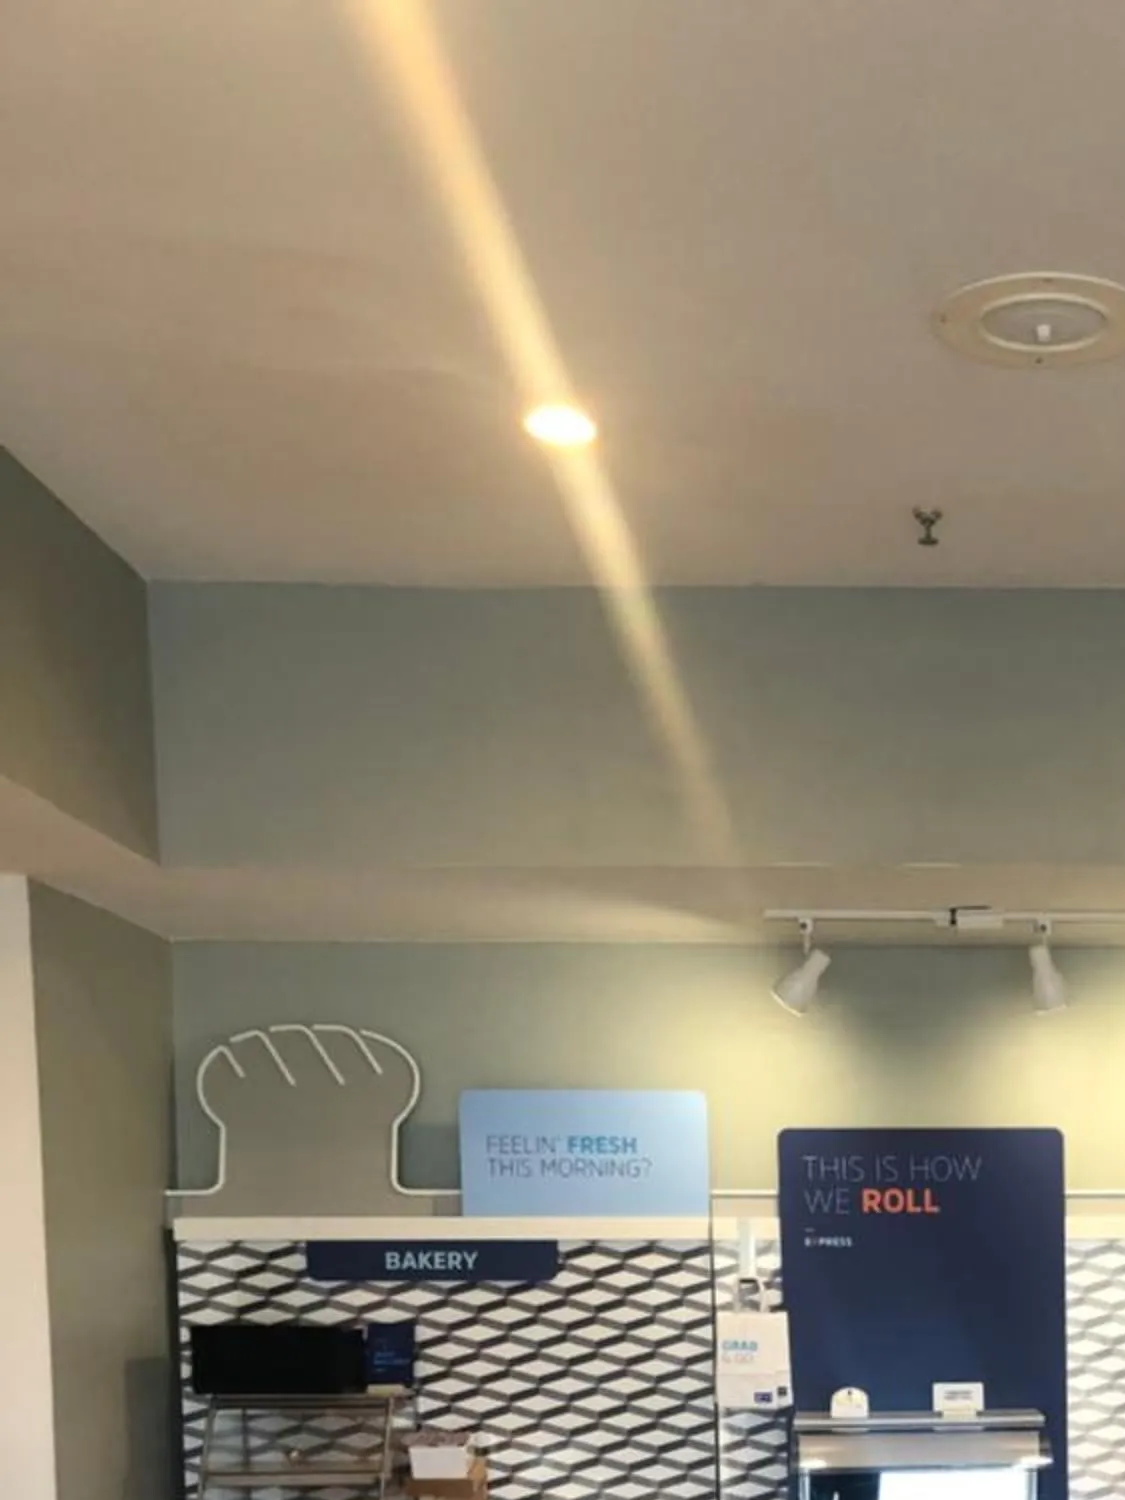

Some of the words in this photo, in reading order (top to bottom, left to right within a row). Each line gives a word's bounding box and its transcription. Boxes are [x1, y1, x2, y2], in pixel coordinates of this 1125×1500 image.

[567, 1136, 638, 1153] FRESH
[488, 1158, 532, 1177] THIS
[540, 1157, 652, 1178] MORNING?
[803, 1155, 866, 1182] THIS
[876, 1156, 899, 1182] IS
[910, 1156, 982, 1182] HOW
[804, 1188, 850, 1215] WE
[862, 1187, 941, 1214] ROLL
[384, 1251, 478, 1270] BAKERY
